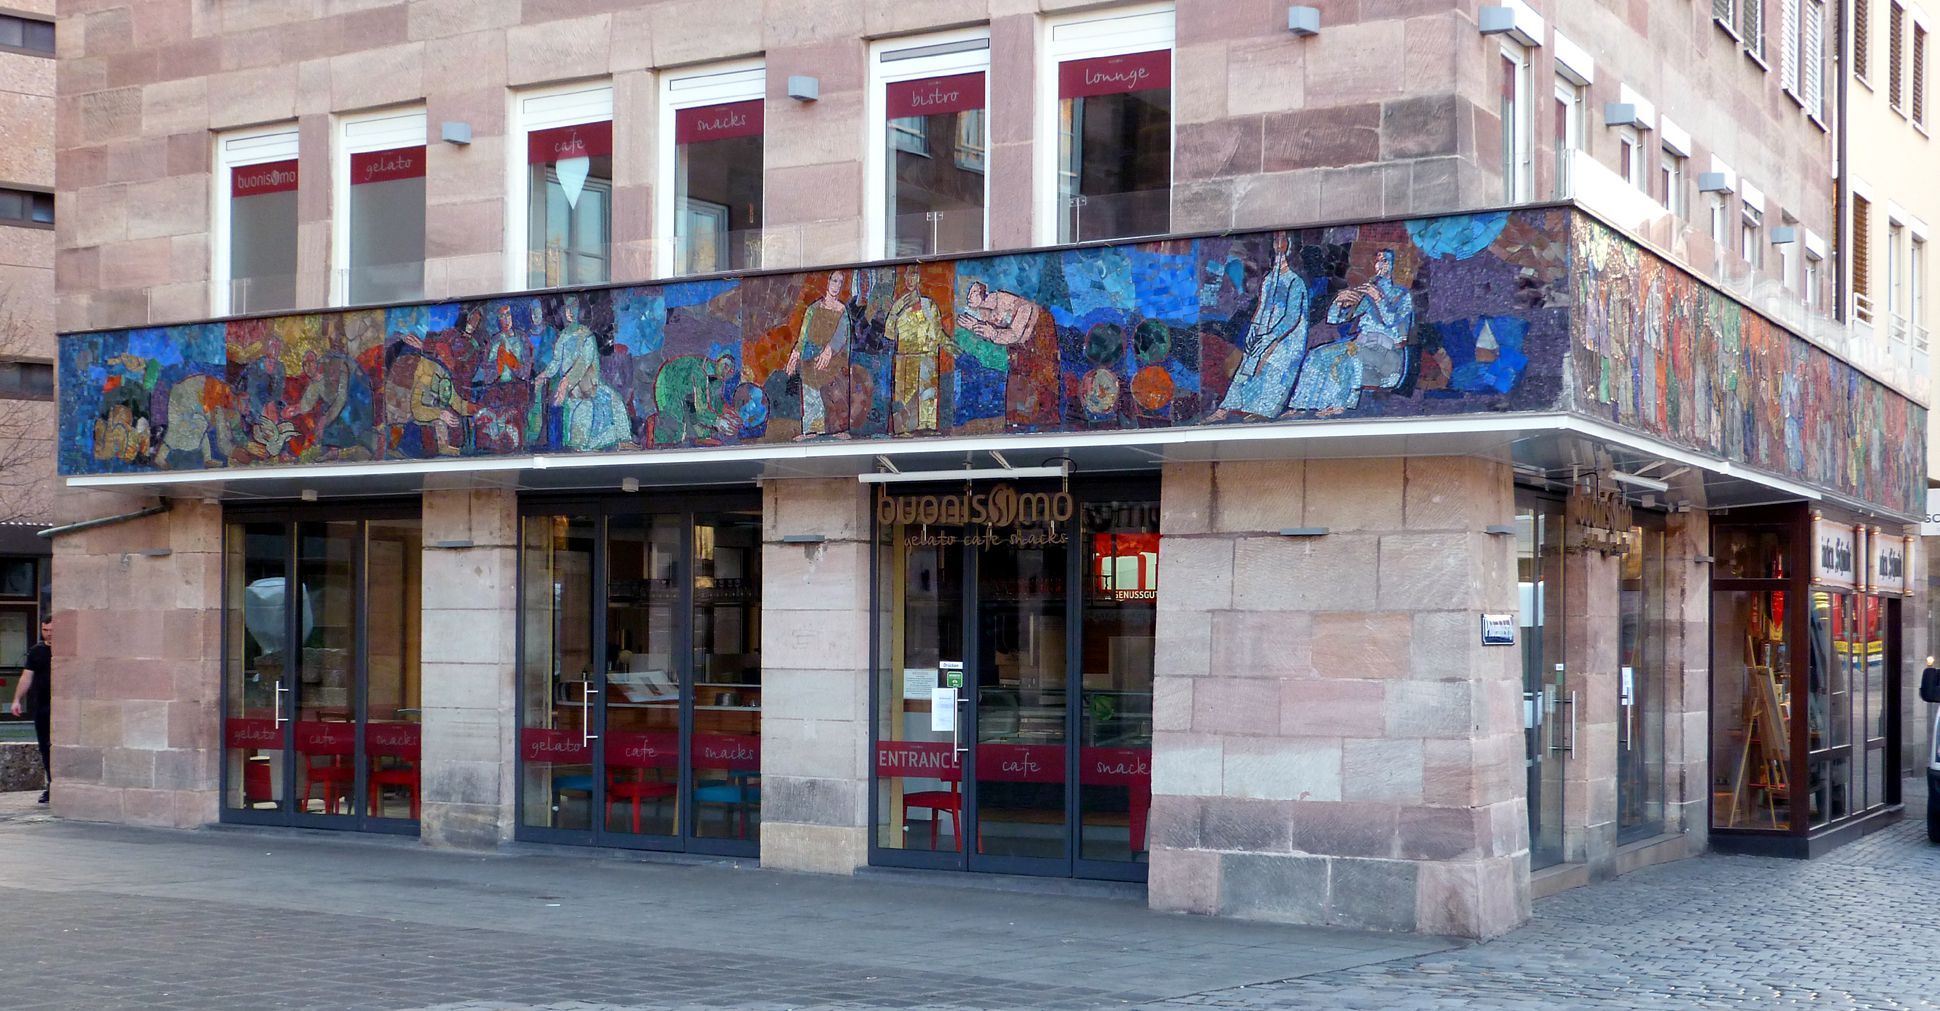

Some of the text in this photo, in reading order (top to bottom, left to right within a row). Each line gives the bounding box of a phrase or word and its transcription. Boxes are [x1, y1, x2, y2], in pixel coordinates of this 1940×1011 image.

[912, 88, 959, 107] bistro
[697, 111, 746, 131] snacks
[554, 131, 585, 154] cafe
[366, 156, 413, 180] gelato
[904, 526, 1068, 555] gelato cafe snacks
[1115, 590, 1157, 599] GENUSSGU
[233, 725, 276, 745] gelato
[309, 727, 336, 747] cafe
[531, 736, 753, 762] gelato cafe snacks
[879, 750, 960, 769] ENTRANCE
[1002, 751, 1041, 777] cafe
